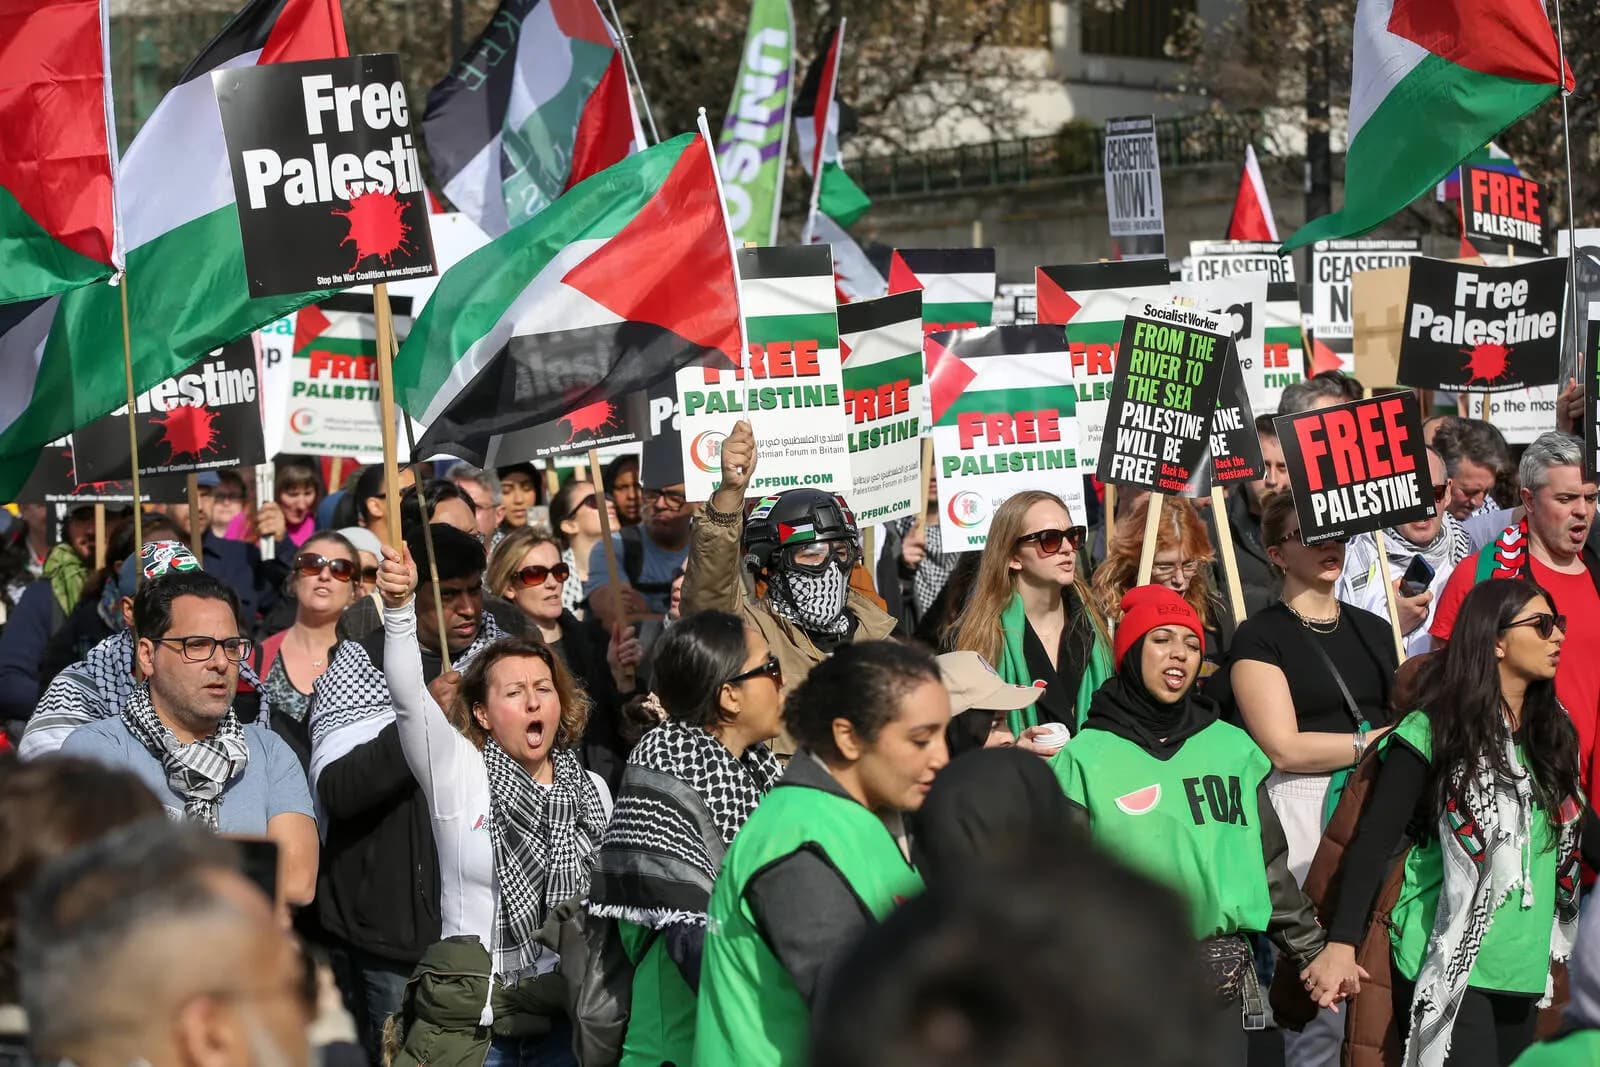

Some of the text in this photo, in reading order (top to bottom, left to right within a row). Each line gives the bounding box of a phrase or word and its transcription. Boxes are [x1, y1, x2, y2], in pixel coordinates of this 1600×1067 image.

[302, 74, 408, 135] Free
[719, 28, 788, 240] UNISO
[242, 134, 423, 209] Palesti
[1107, 137, 1156, 172] CEASEFIRE
[1471, 168, 1542, 225] FREE
[1473, 211, 1542, 246] PALESTINE
[317, 276, 332, 286] Stop
[332, 274, 343, 284] the
[343, 273, 355, 283] War
[356, 269, 385, 281] Coalition
[1320, 255, 1411, 283] CEASE
[1330, 285, 1354, 322] N
[1454, 272, 1529, 309] Free
[1133, 321, 1184, 355] FROM
[1188, 333, 1217, 362] THE
[1409, 308, 1557, 347] Palestine
[1129, 348, 1205, 386] RIVER TO
[111, 360, 256, 417] estine
[684, 384, 839, 416] PALESTINE
[1127, 374, 1161, 405] THE
[1163, 382, 1193, 411] SEA
[1119, 401, 1205, 441] PALESTINE
[1475, 399, 1558, 416] Sp the mas
[848, 417, 919, 453] LESTINE
[957, 409, 1061, 450] FREE
[1115, 427, 1184, 464] WILL BE
[1209, 433, 1230, 457] BE
[1293, 398, 1415, 492] FREE
[757, 442, 845, 459] stinian Forum in Britain
[942, 448, 1077, 478] PALESTINE
[1215, 456, 1245, 469] Back the
[711, 474, 834, 492] W.PFBUK.COM
[1110, 455, 1157, 486] FREE
[1160, 463, 1178, 477] Back
[1178, 467, 1189, 479] the
[1158, 479, 1196, 493] resistance
[1218, 468, 1254, 480] resistance
[1310, 472, 1422, 527] PALESTINE
[1182, 774, 1249, 827] FOA
